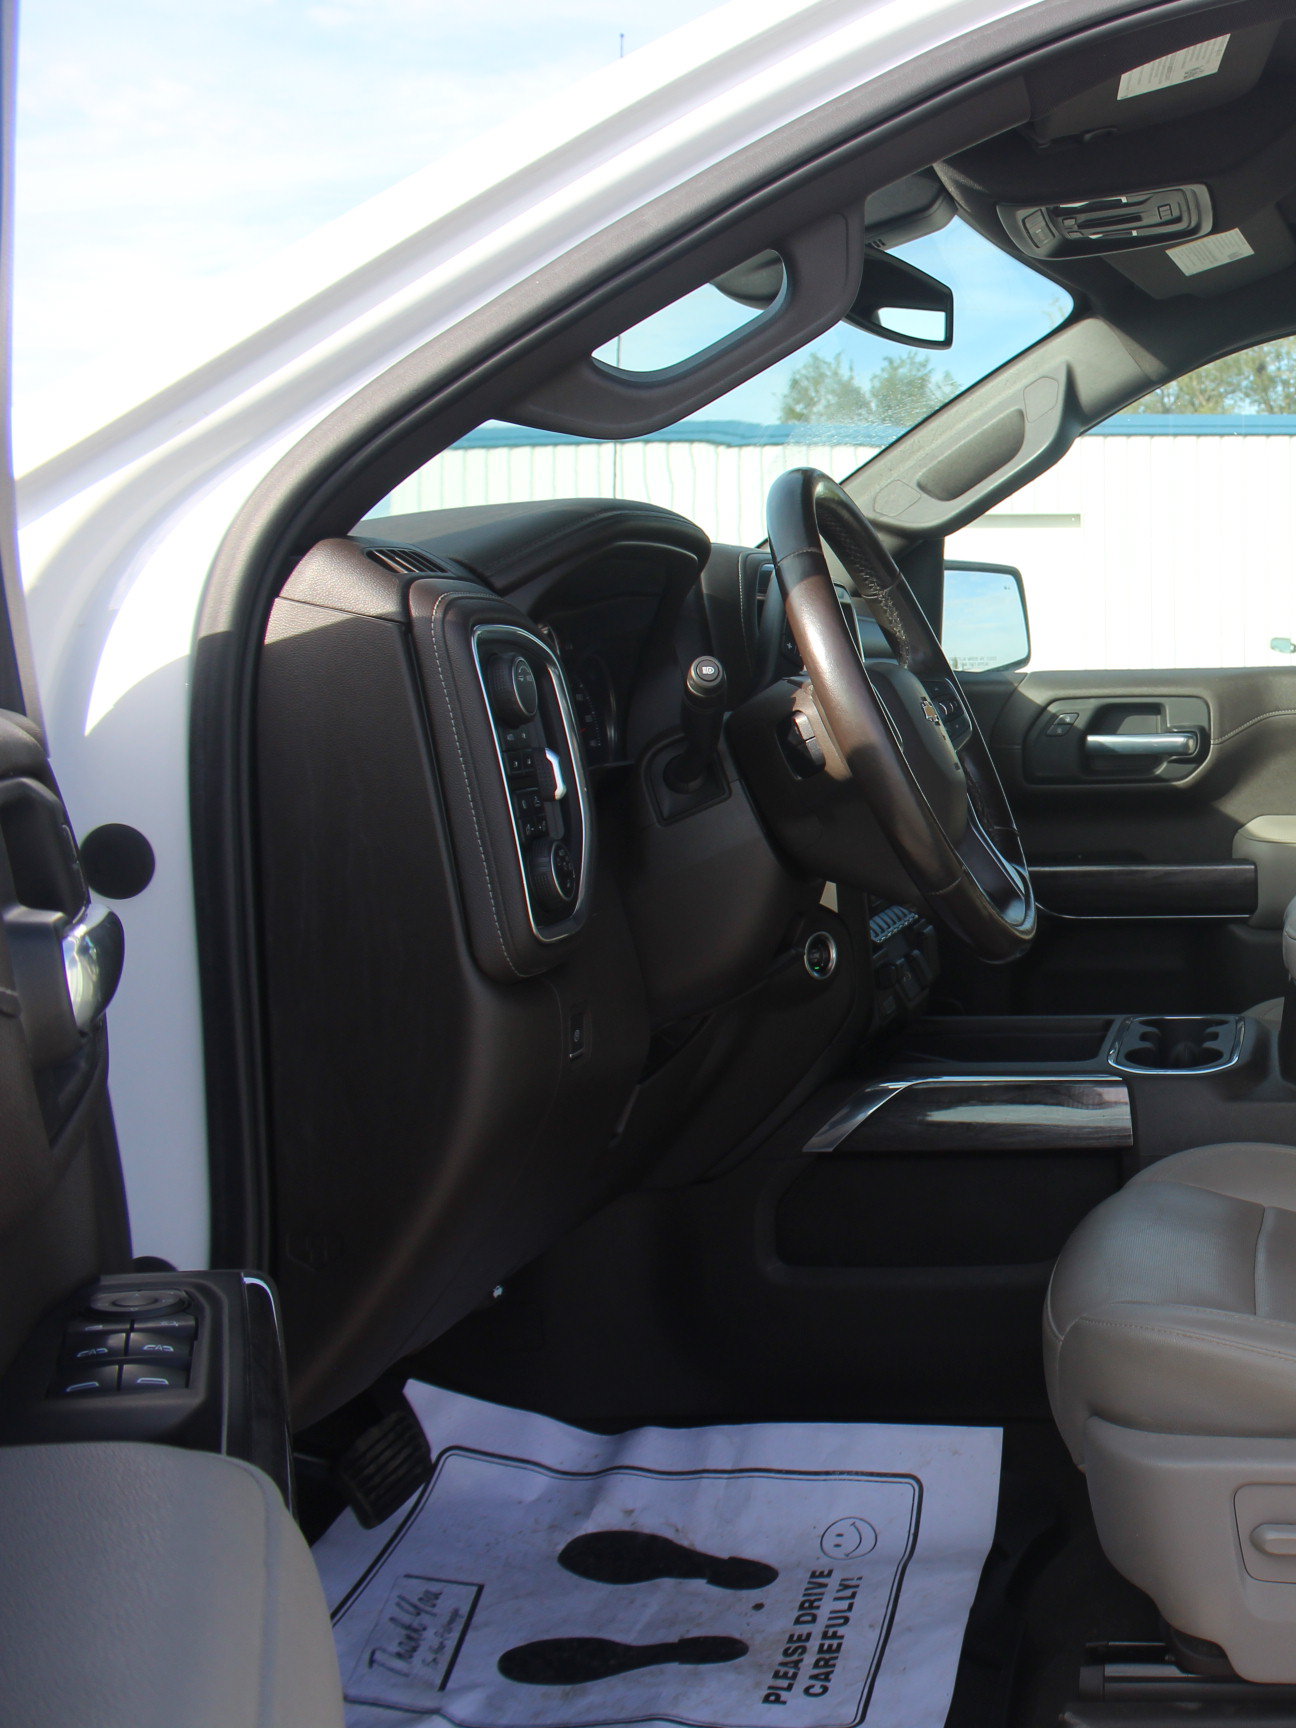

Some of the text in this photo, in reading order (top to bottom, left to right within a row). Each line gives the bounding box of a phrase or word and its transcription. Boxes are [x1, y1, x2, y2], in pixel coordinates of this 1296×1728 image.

[368, 1616, 427, 1678] Thank
[395, 1589, 443, 1617] You
[761, 1568, 834, 1705] PLEASE DRIVE
[803, 1576, 863, 1697] CAREFULLY!
